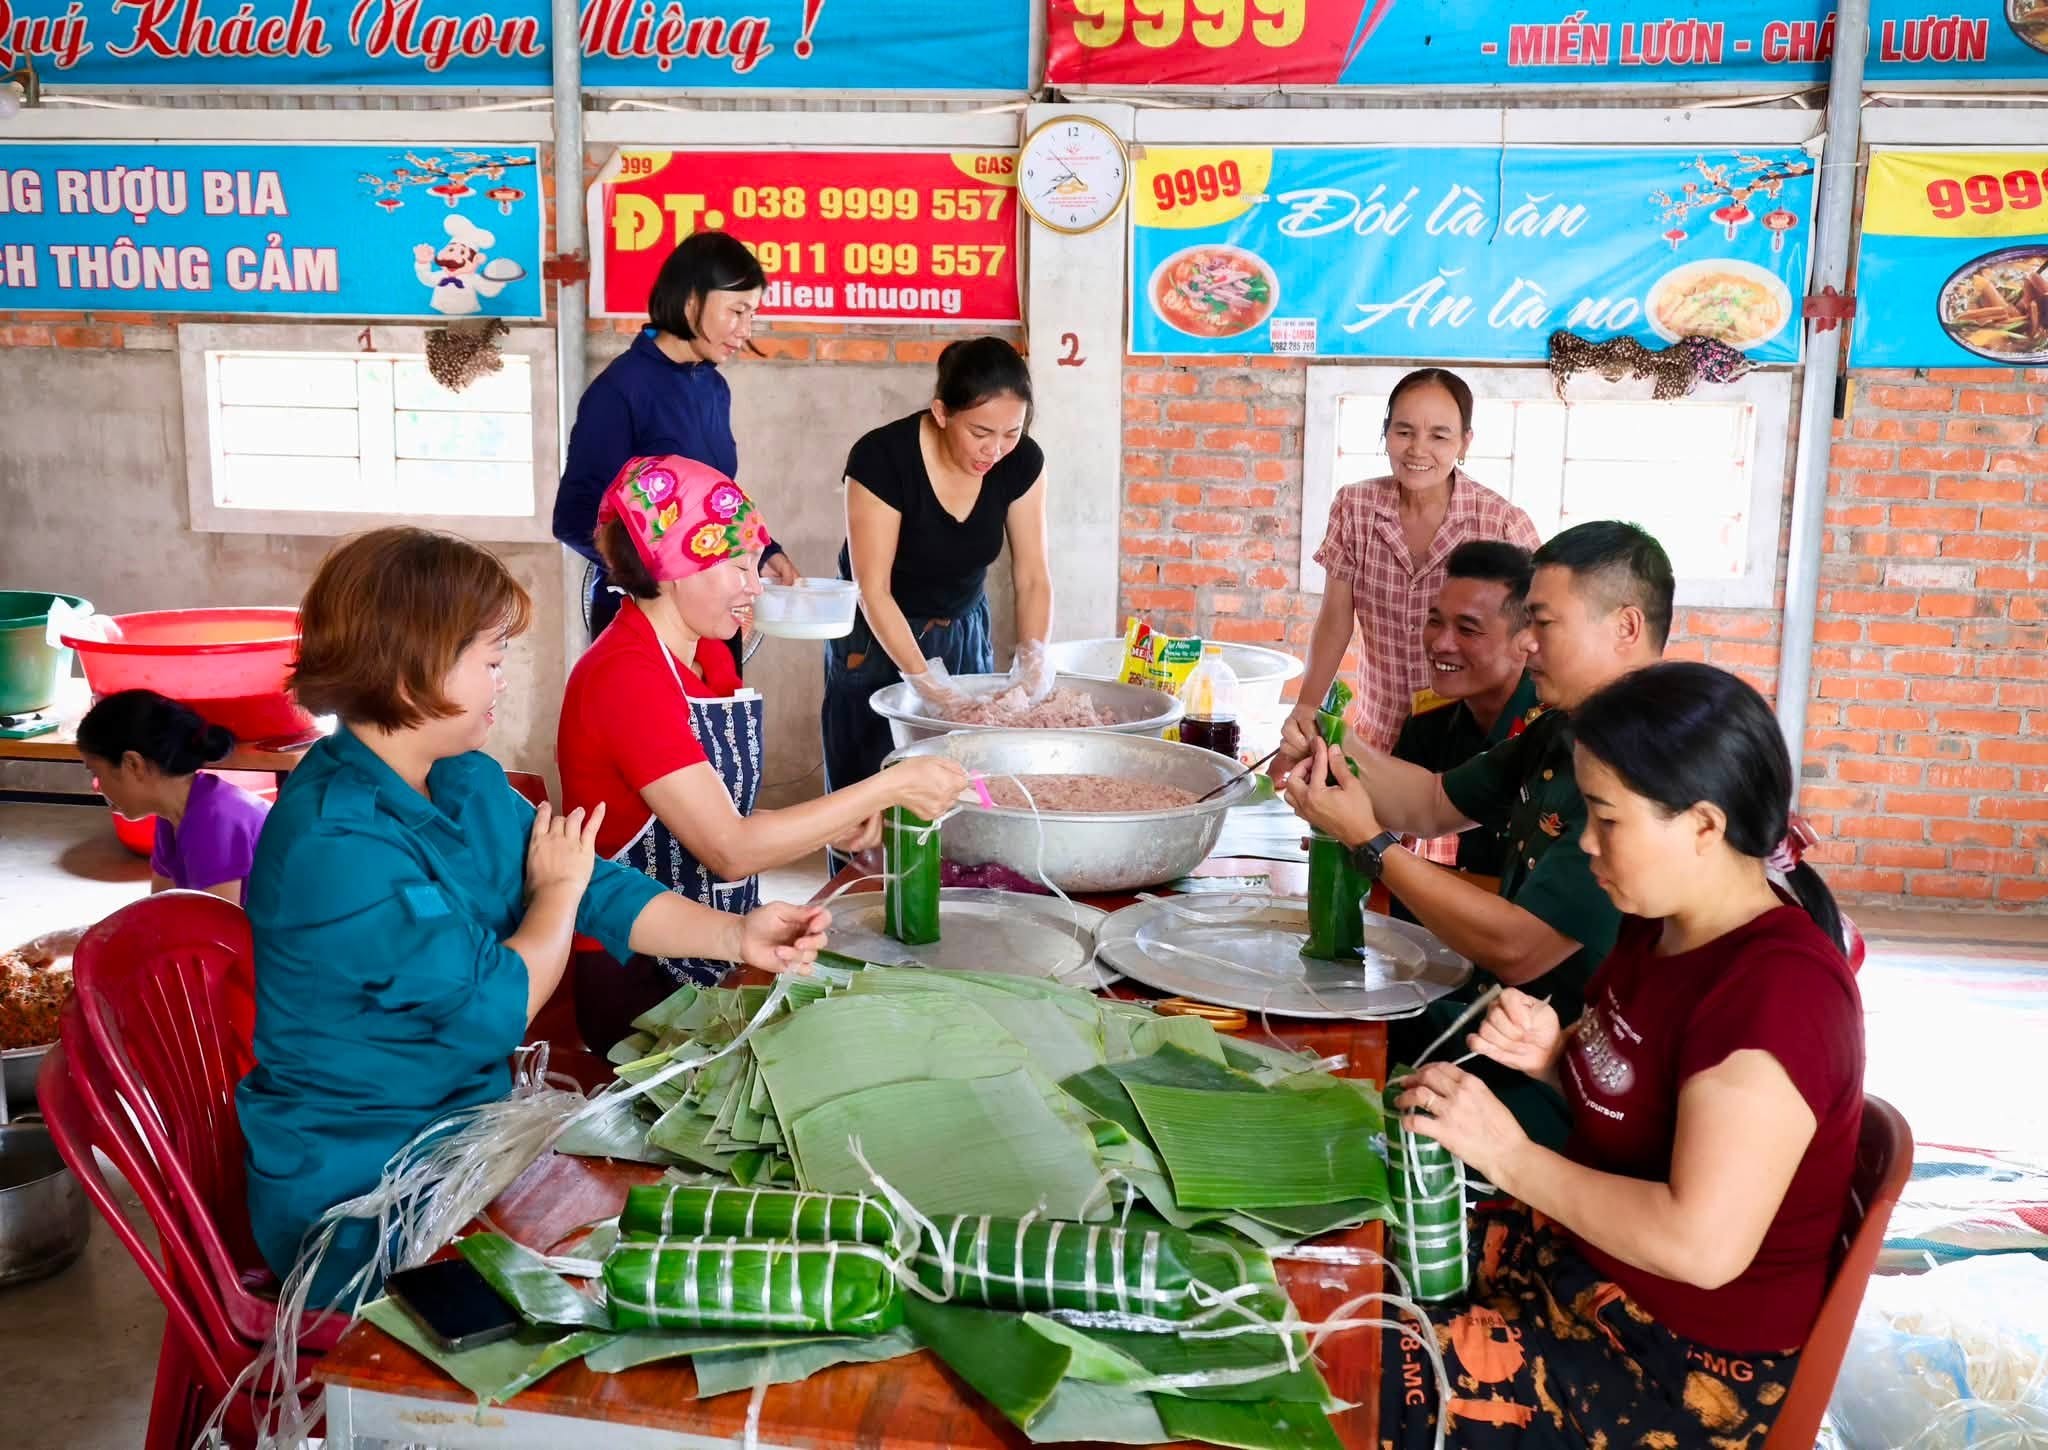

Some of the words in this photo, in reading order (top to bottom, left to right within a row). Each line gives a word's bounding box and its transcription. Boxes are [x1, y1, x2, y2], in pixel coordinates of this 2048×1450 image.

[0, 0, 93, 69] uý
[106, 0, 332, 58] Khách
[349, 0, 544, 72] Ngon
[1508, 10, 1610, 66] MIẾN
[1619, 18, 1725, 65] LƯƠN
[1762, 12, 1868, 63] CHÁ
[1880, 15, 1989, 63] LƯƠN
[1066, 127, 1080, 137] 12
[975, 155, 1014, 175] GAS
[1027, 168, 1034, 179] 9
[56, 164, 188, 225] RƯỢU
[202, 170, 289, 216] BIA
[1153, 160, 1242, 211] 9999
[1926, 166, 2048, 219] 999
[733, 186, 806, 220] 038
[819, 187, 919, 221] 9999
[931, 189, 1008, 222] 557
[1070, 213, 1077, 224] 6
[1276, 183, 1420, 238] Đói
[1425, 183, 1490, 236] là
[1504, 192, 1590, 238] ăn
[0, 243, 38, 288] H
[49, 235, 211, 291] THÔNG
[226, 231, 339, 293] CẢM
[743, 241, 827, 275] 911
[844, 243, 918, 276] 099
[931, 244, 1007, 277] 557
[763, 281, 834, 309] dieu
[844, 283, 962, 314] thuong
[1342, 265, 1478, 334] Ăn
[1487, 276, 1552, 328] là
[1564, 297, 1640, 331] no
[358, 326, 378, 352] 1
[1057, 332, 1088, 367] 2
